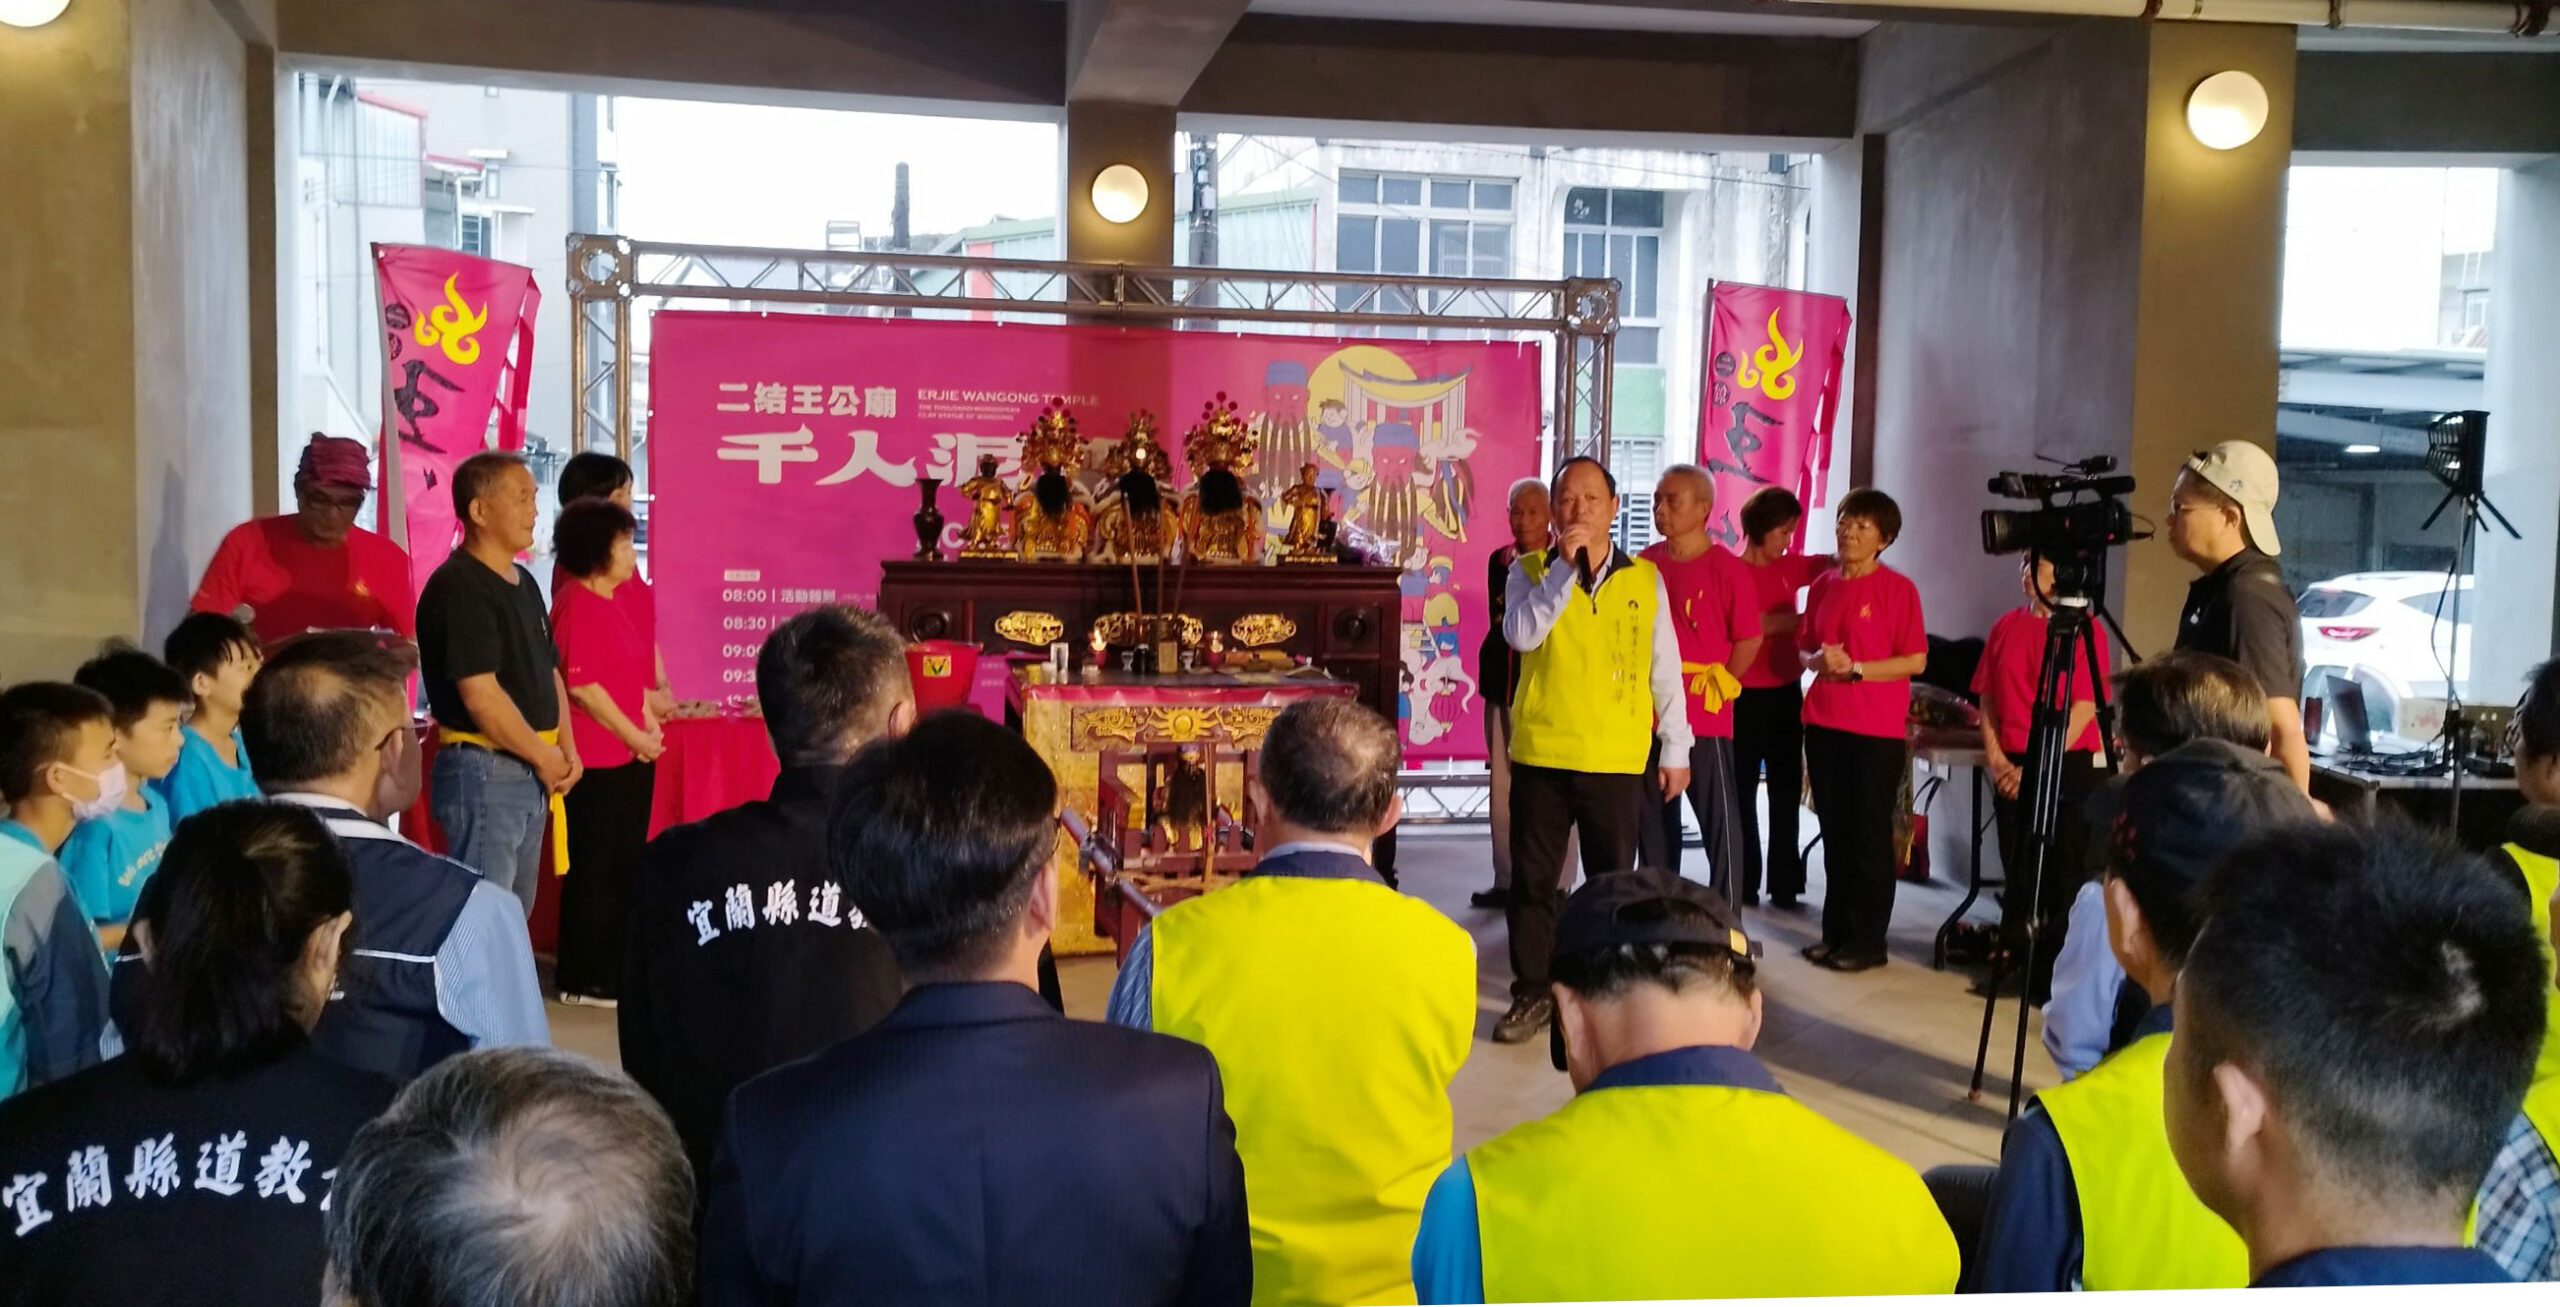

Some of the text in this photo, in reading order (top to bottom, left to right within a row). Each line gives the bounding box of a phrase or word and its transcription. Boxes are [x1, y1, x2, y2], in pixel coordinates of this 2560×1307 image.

[716, 381, 897, 418] 二結王公廟
[917, 388, 960, 402] ERJIE
[962, 389, 1040, 404] WANGONG
[716, 423, 1122, 488] 千人泥
[722, 589, 767, 603] 08:00
[723, 617, 767, 630] 08:30
[722, 669, 757, 683] 09:3
[2, 1130, 338, 1238] 宜蘭縣道教
